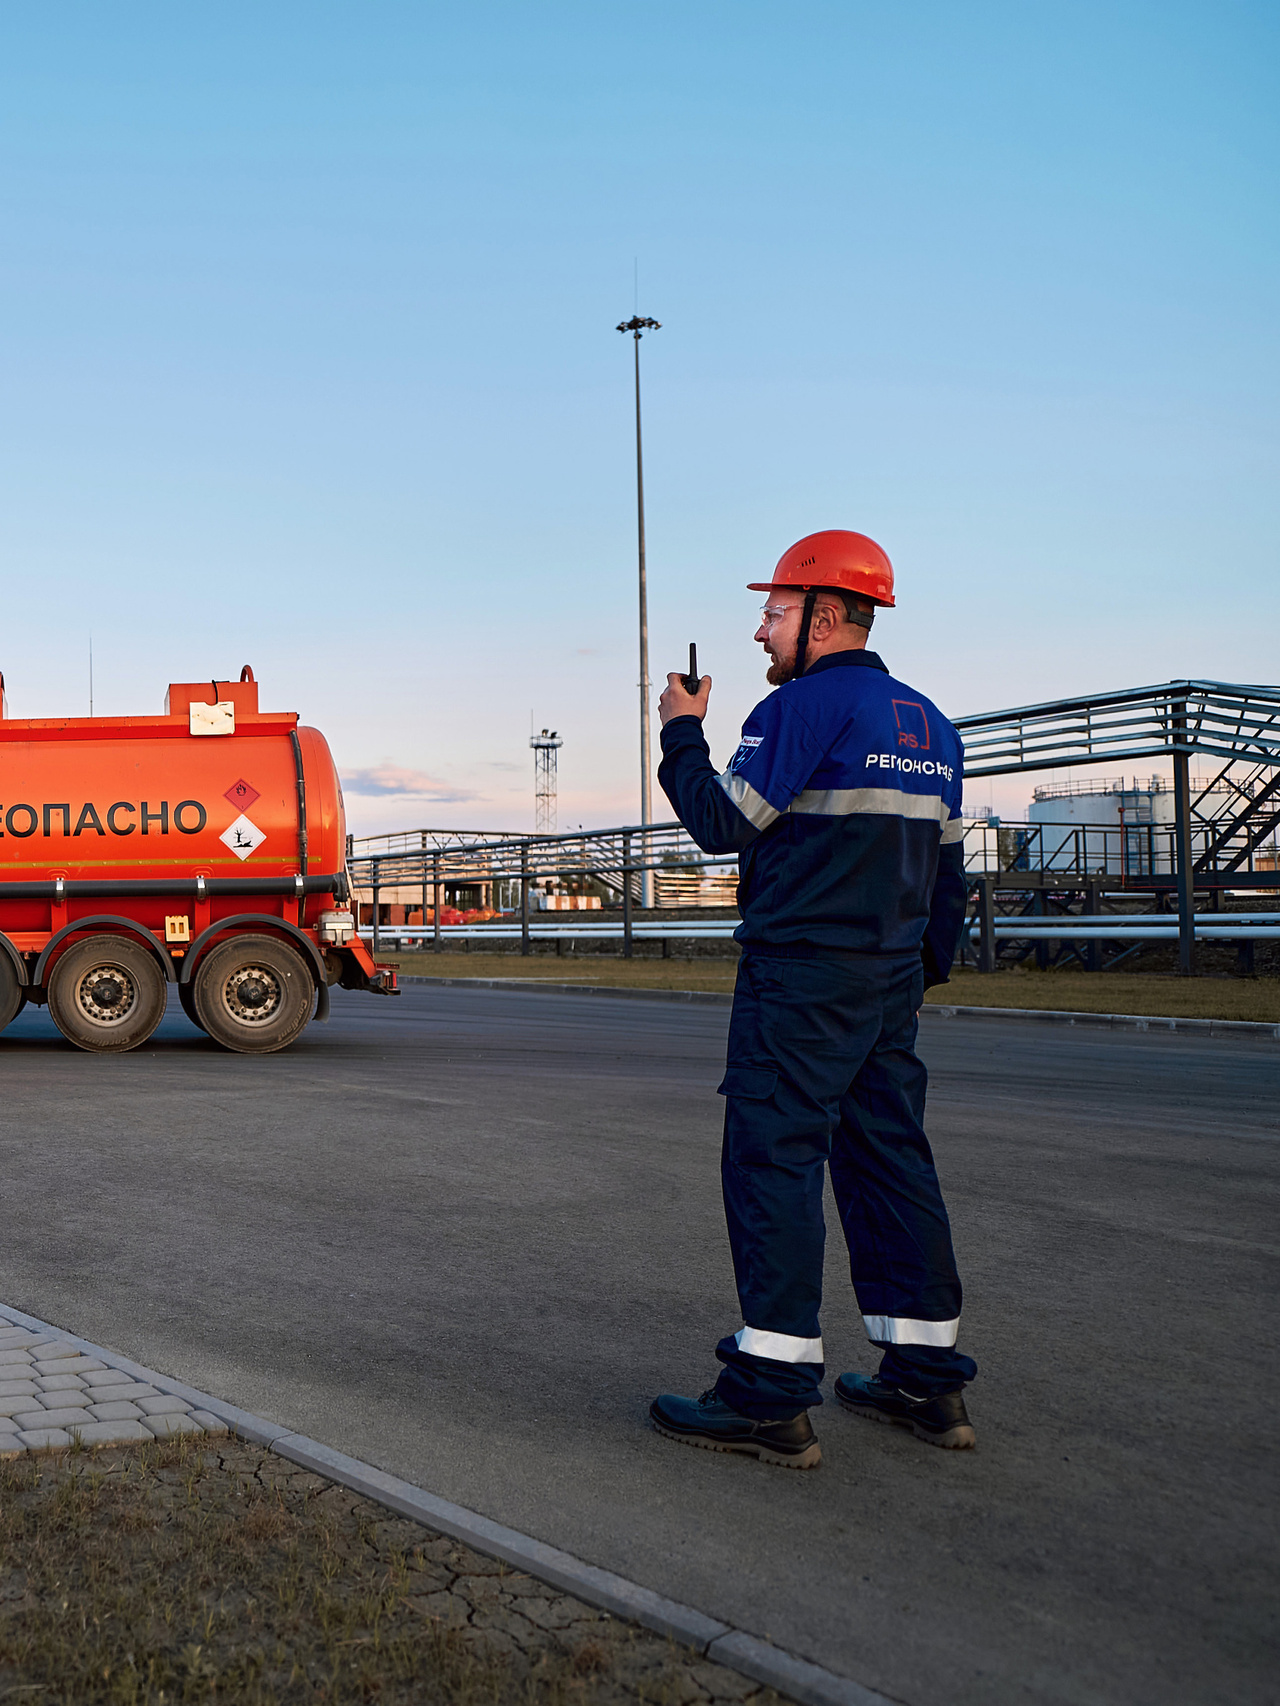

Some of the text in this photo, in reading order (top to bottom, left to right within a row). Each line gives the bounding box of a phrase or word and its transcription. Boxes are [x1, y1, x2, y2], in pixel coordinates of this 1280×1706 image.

[898, 731, 919, 749] RS
[277, 999, 308, 1042] Cordiant
[80, 1034, 131, 1047] Cordiant
